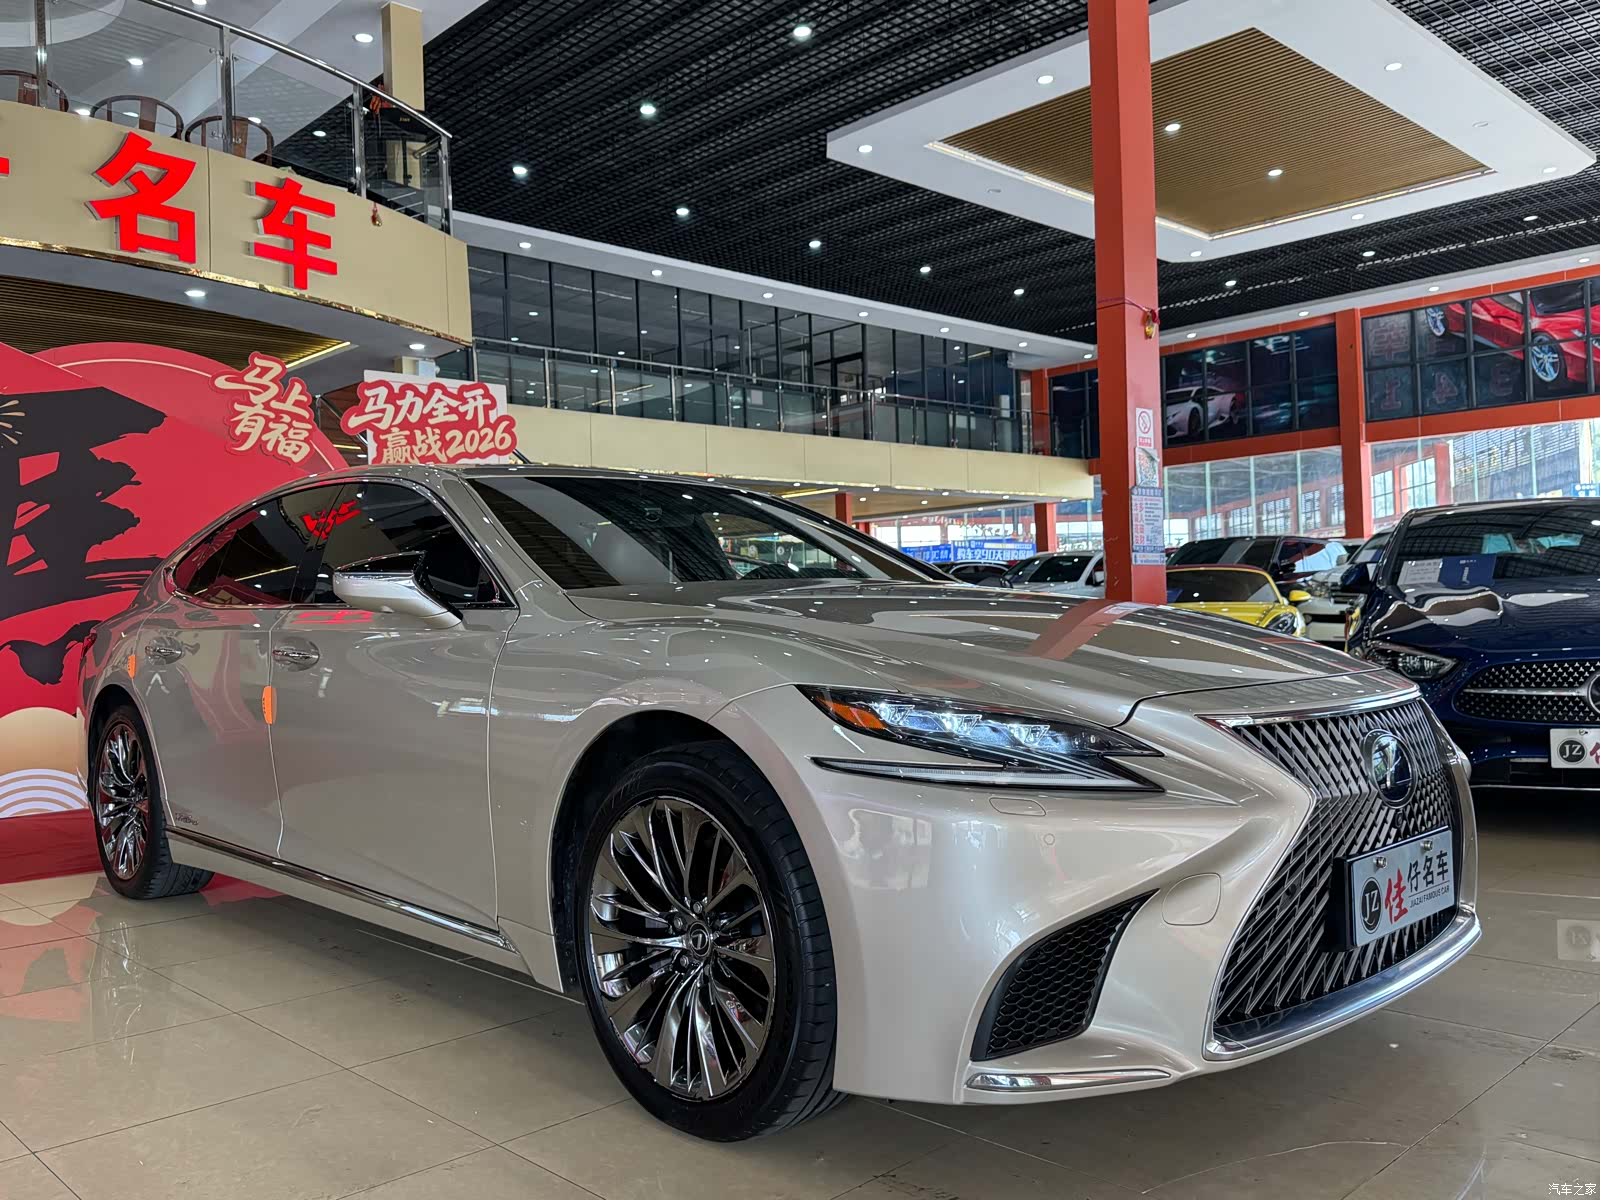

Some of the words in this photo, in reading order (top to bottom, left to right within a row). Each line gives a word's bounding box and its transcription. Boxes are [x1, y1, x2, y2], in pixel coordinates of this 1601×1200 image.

[348, 387, 493, 429] 马力全开
[379, 420, 513, 465] 赢战2026
[1562, 744, 1583, 759] JZ
[1363, 889, 1380, 923] JZ
